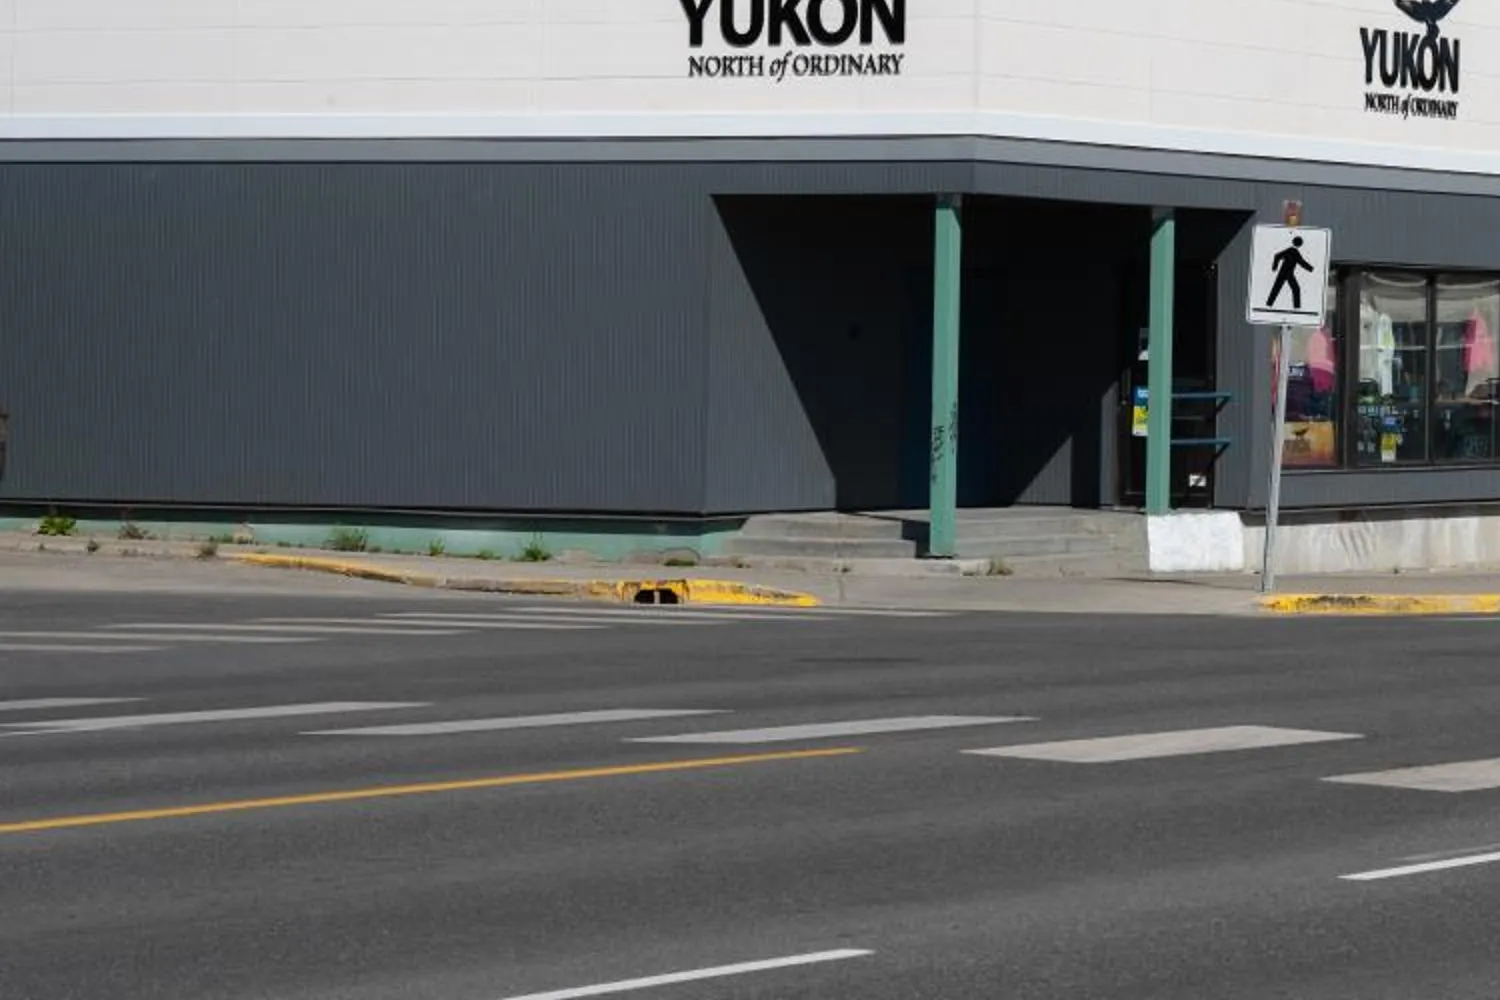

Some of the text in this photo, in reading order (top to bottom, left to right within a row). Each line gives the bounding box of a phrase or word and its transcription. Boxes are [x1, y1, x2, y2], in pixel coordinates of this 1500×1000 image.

[688, 50, 904, 82] NORTH of ORDINARY
[1360, 27, 1460, 94] YUKON
[1364, 92, 1459, 120] NORTH of ORDINARY
